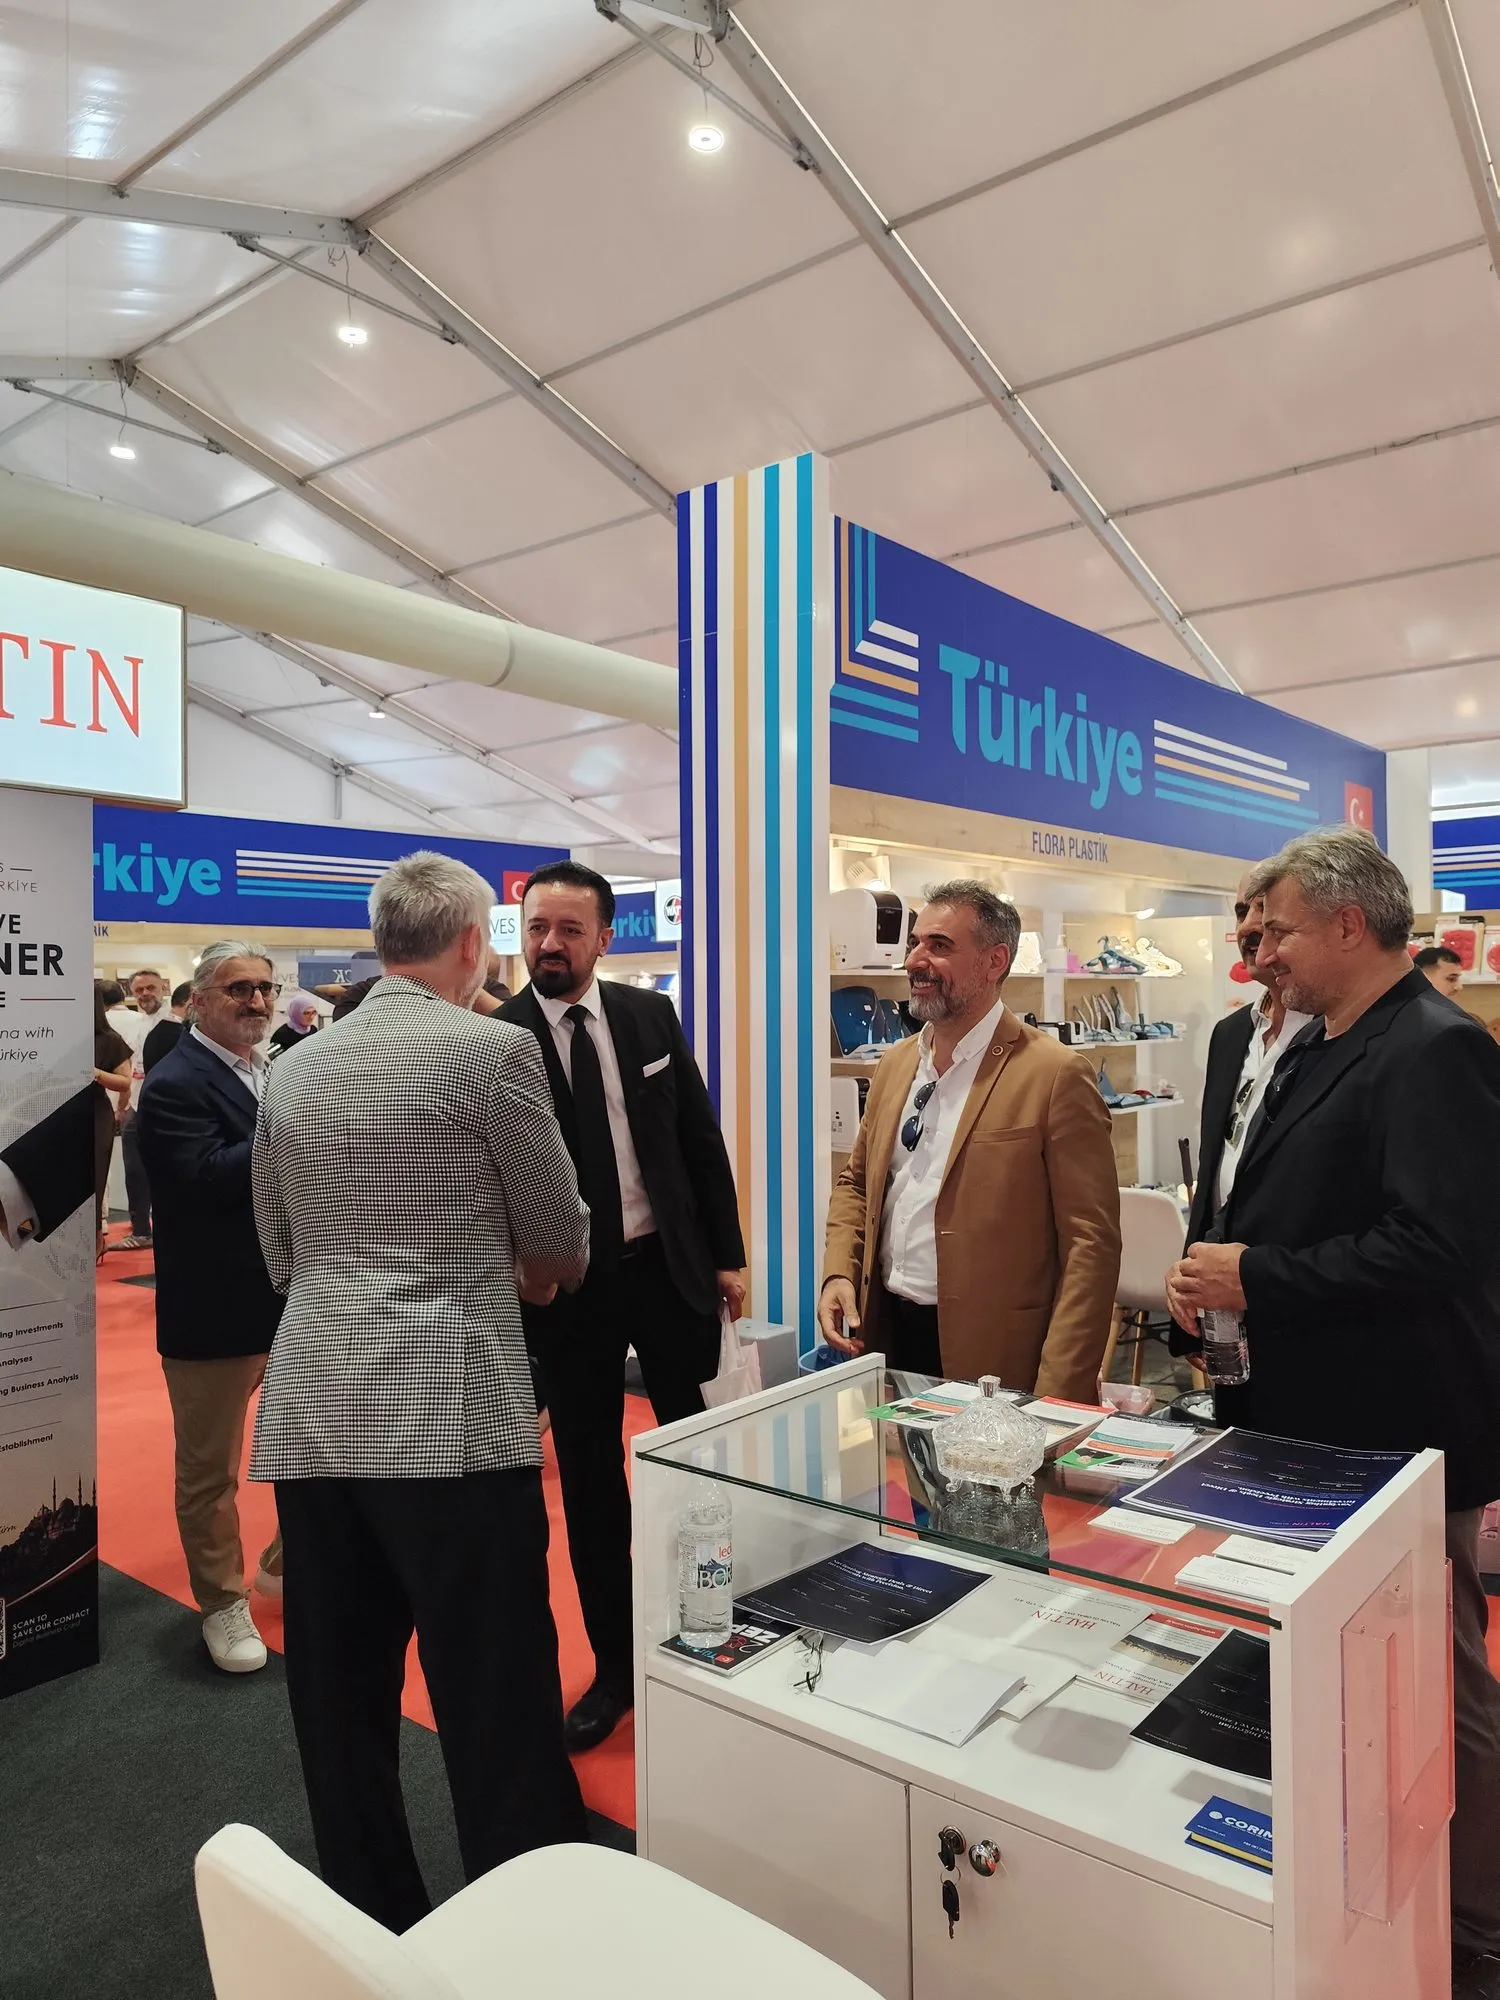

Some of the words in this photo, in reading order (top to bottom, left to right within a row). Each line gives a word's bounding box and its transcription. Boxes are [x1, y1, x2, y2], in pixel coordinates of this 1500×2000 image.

[938, 644, 1143, 810] Türkiye
[1032, 831, 1066, 857] FLORA
[1067, 834, 1109, 863] PLASTİK
[25, 1026, 54, 1038] with
[16, 1322, 64, 1336] Investments
[11, 1381, 45, 1393] Business
[47, 1373, 79, 1386] Analysis
[1200, 1482, 1228, 1492] Direct
[1239, 1491, 1263, 1500] Deals
[1264, 1496, 1304, 1505] Strategic
[12, 1617, 36, 1631] SCAN
[36, 1613, 48, 1623] TO
[12, 1626, 34, 1640] SAVE
[35, 1621, 52, 1633] OUR
[53, 1608, 91, 1626] CONTACT
[1031, 1609, 1097, 1630] HALTIN
[1093, 1670, 1154, 1696] HALTIN
